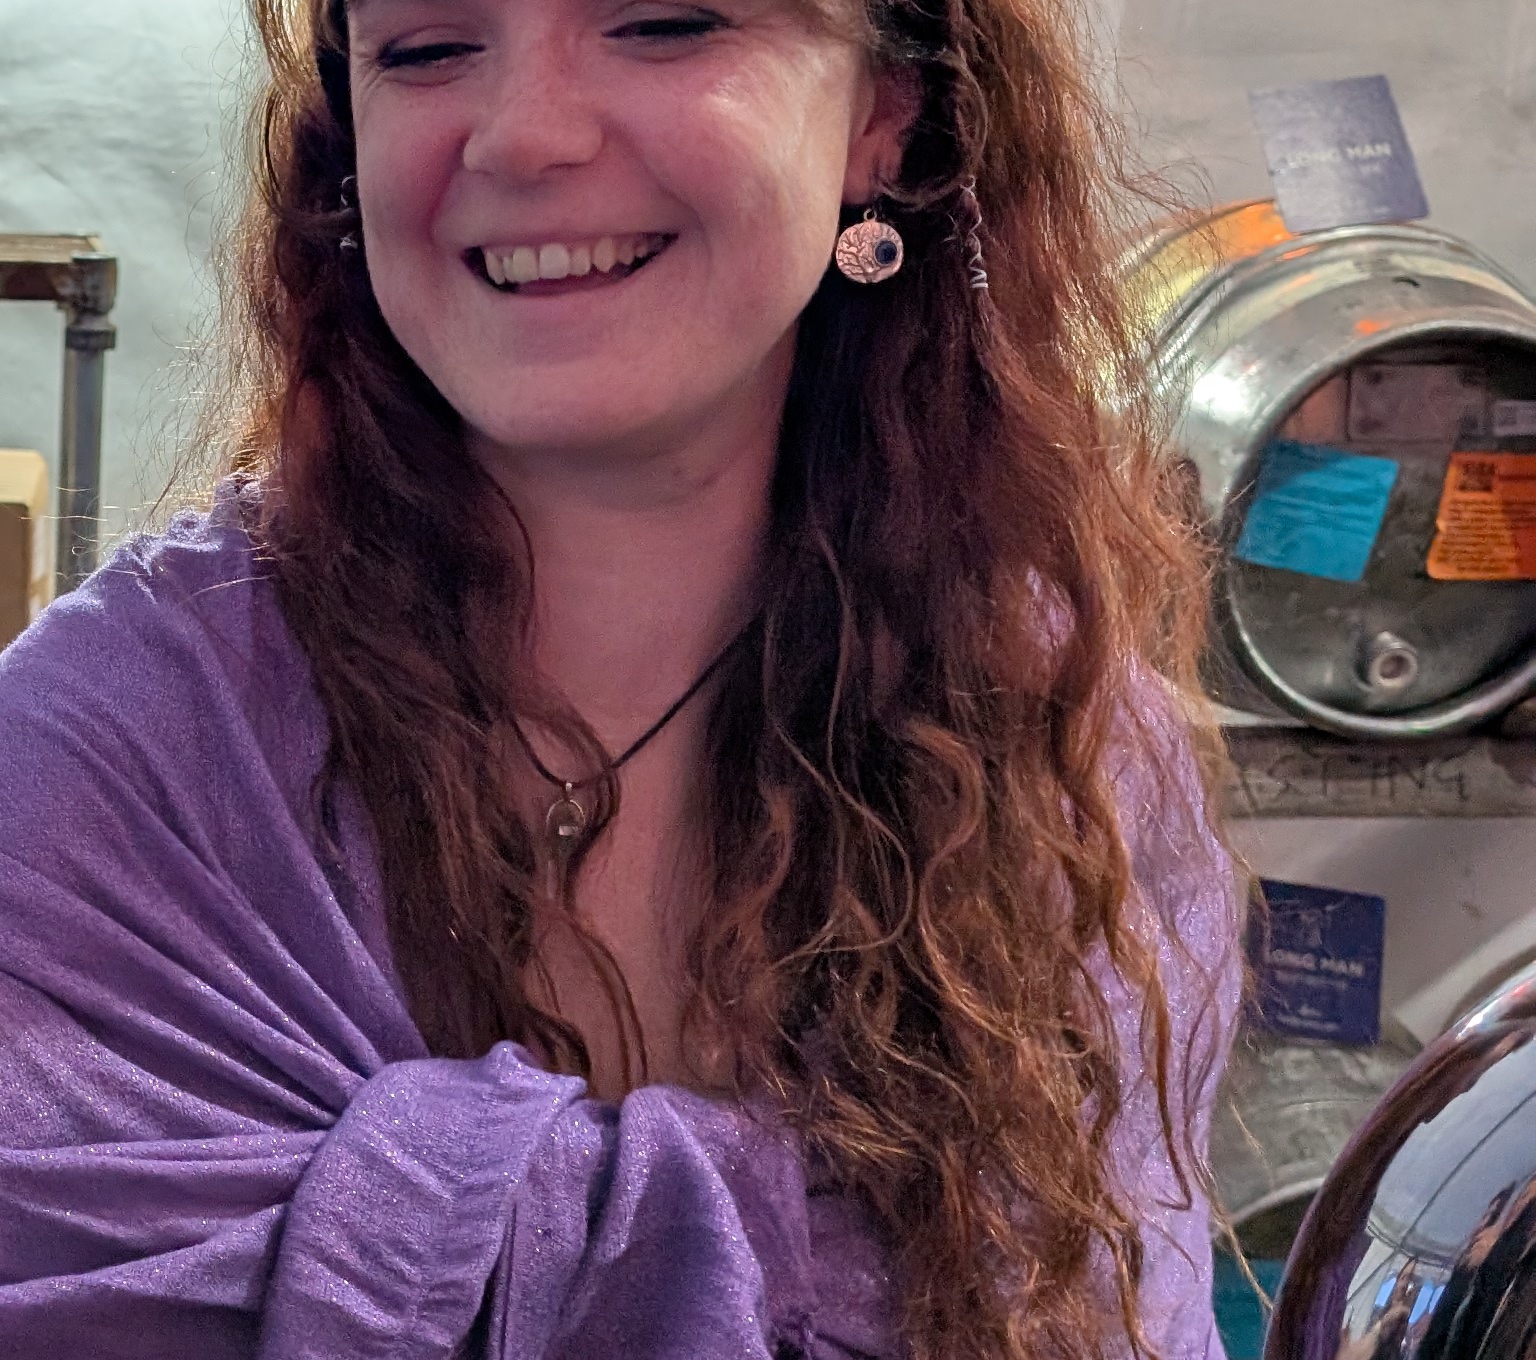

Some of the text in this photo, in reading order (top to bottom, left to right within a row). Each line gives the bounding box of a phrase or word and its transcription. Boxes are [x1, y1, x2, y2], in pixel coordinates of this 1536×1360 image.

[1285, 148, 1341, 169] LONG
[1345, 142, 1392, 160] MAN
[1319, 958, 1365, 977] MAN
